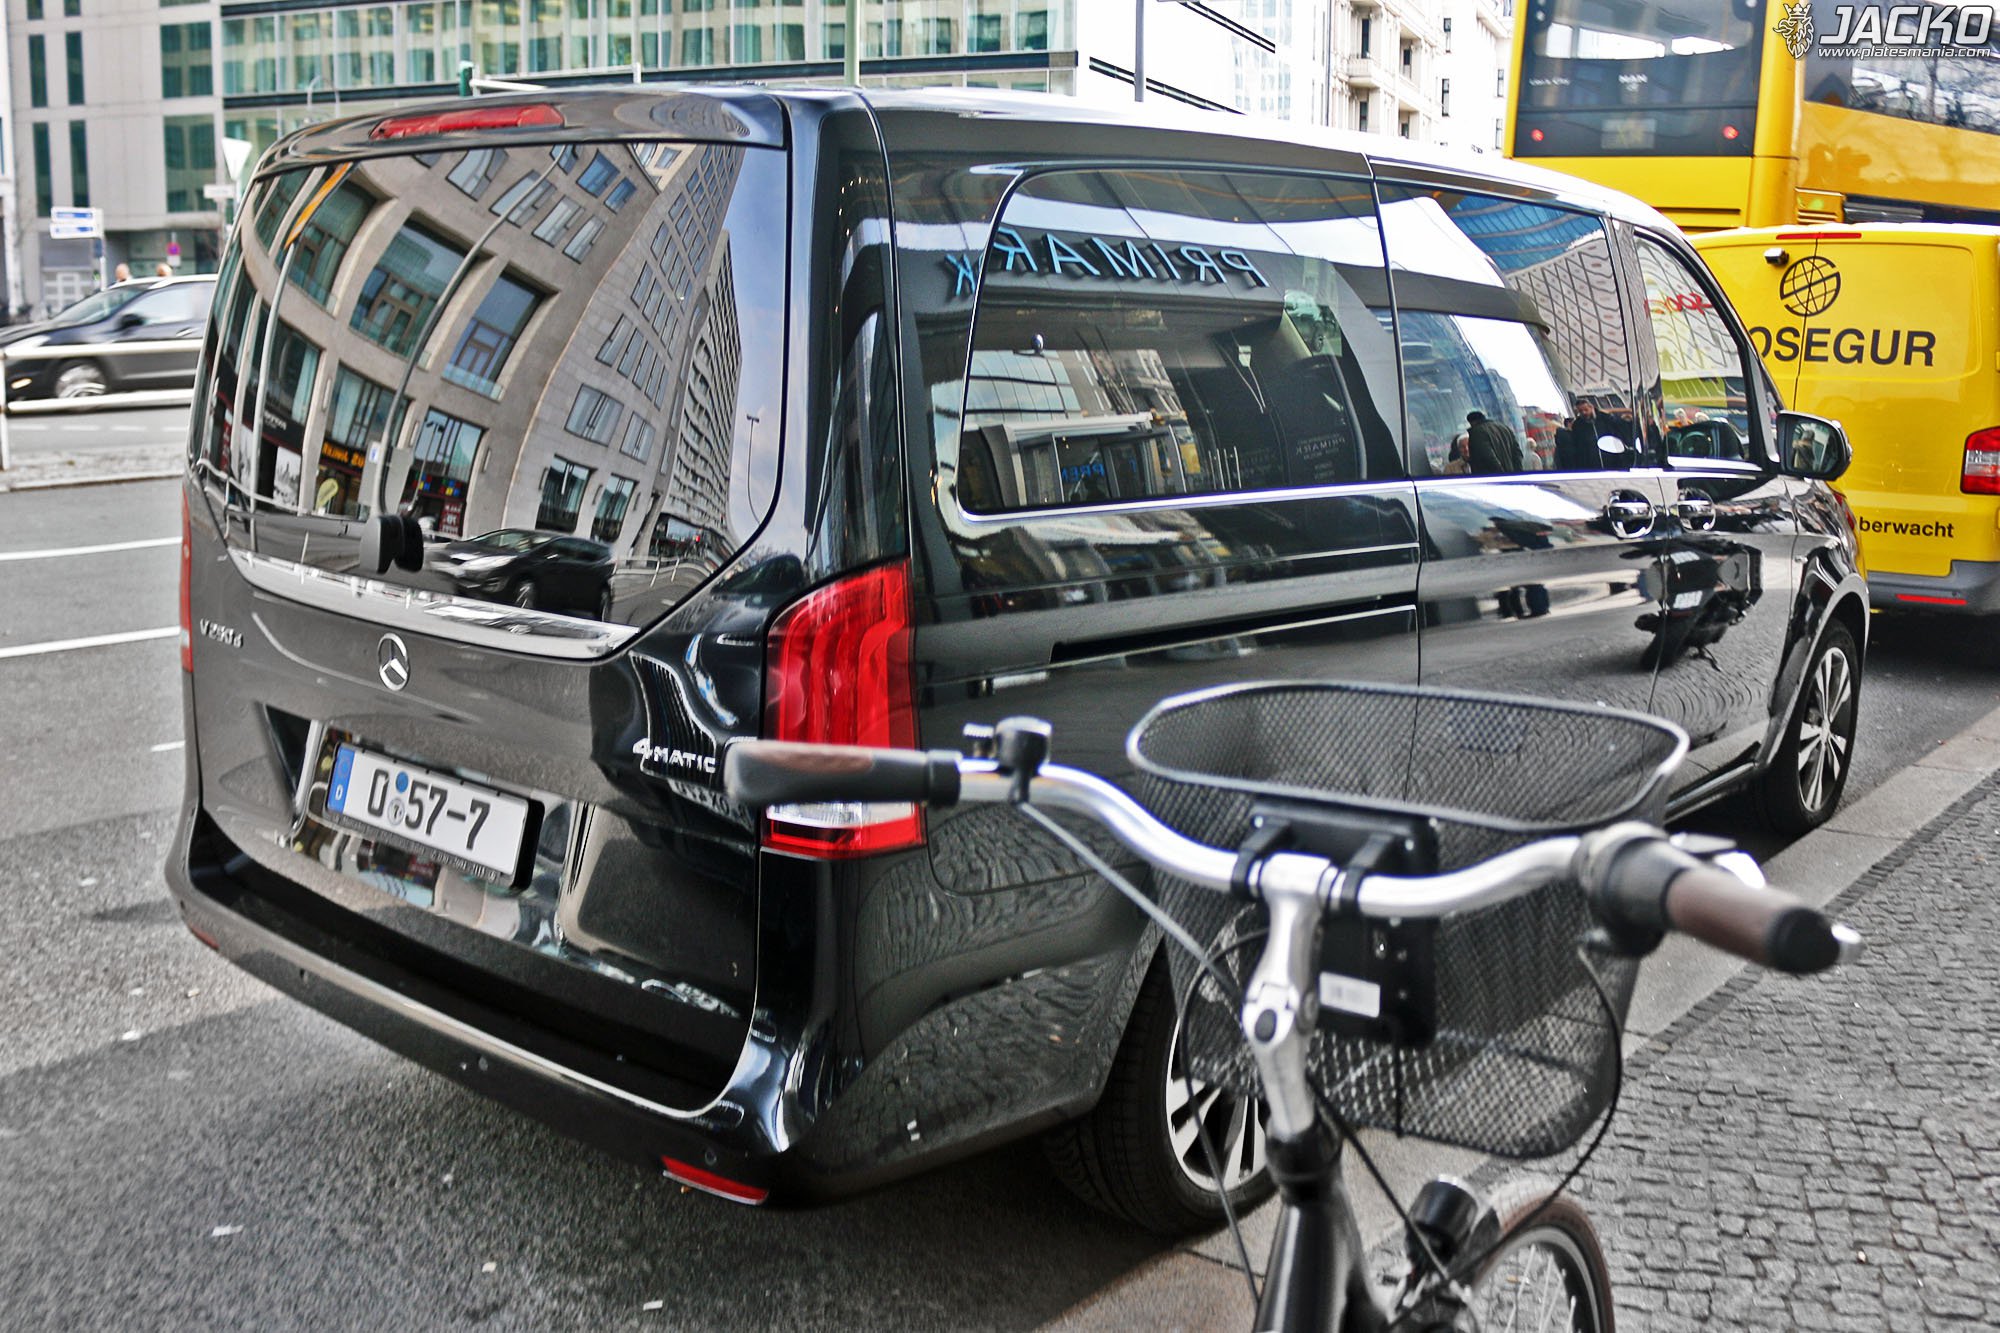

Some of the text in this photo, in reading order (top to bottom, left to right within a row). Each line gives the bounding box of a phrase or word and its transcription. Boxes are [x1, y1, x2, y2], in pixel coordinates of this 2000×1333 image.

[1859, 516, 1955, 539] berwacht
[632, 737, 716, 774] 4MATIC
[404, 780, 491, 851] 57-7
